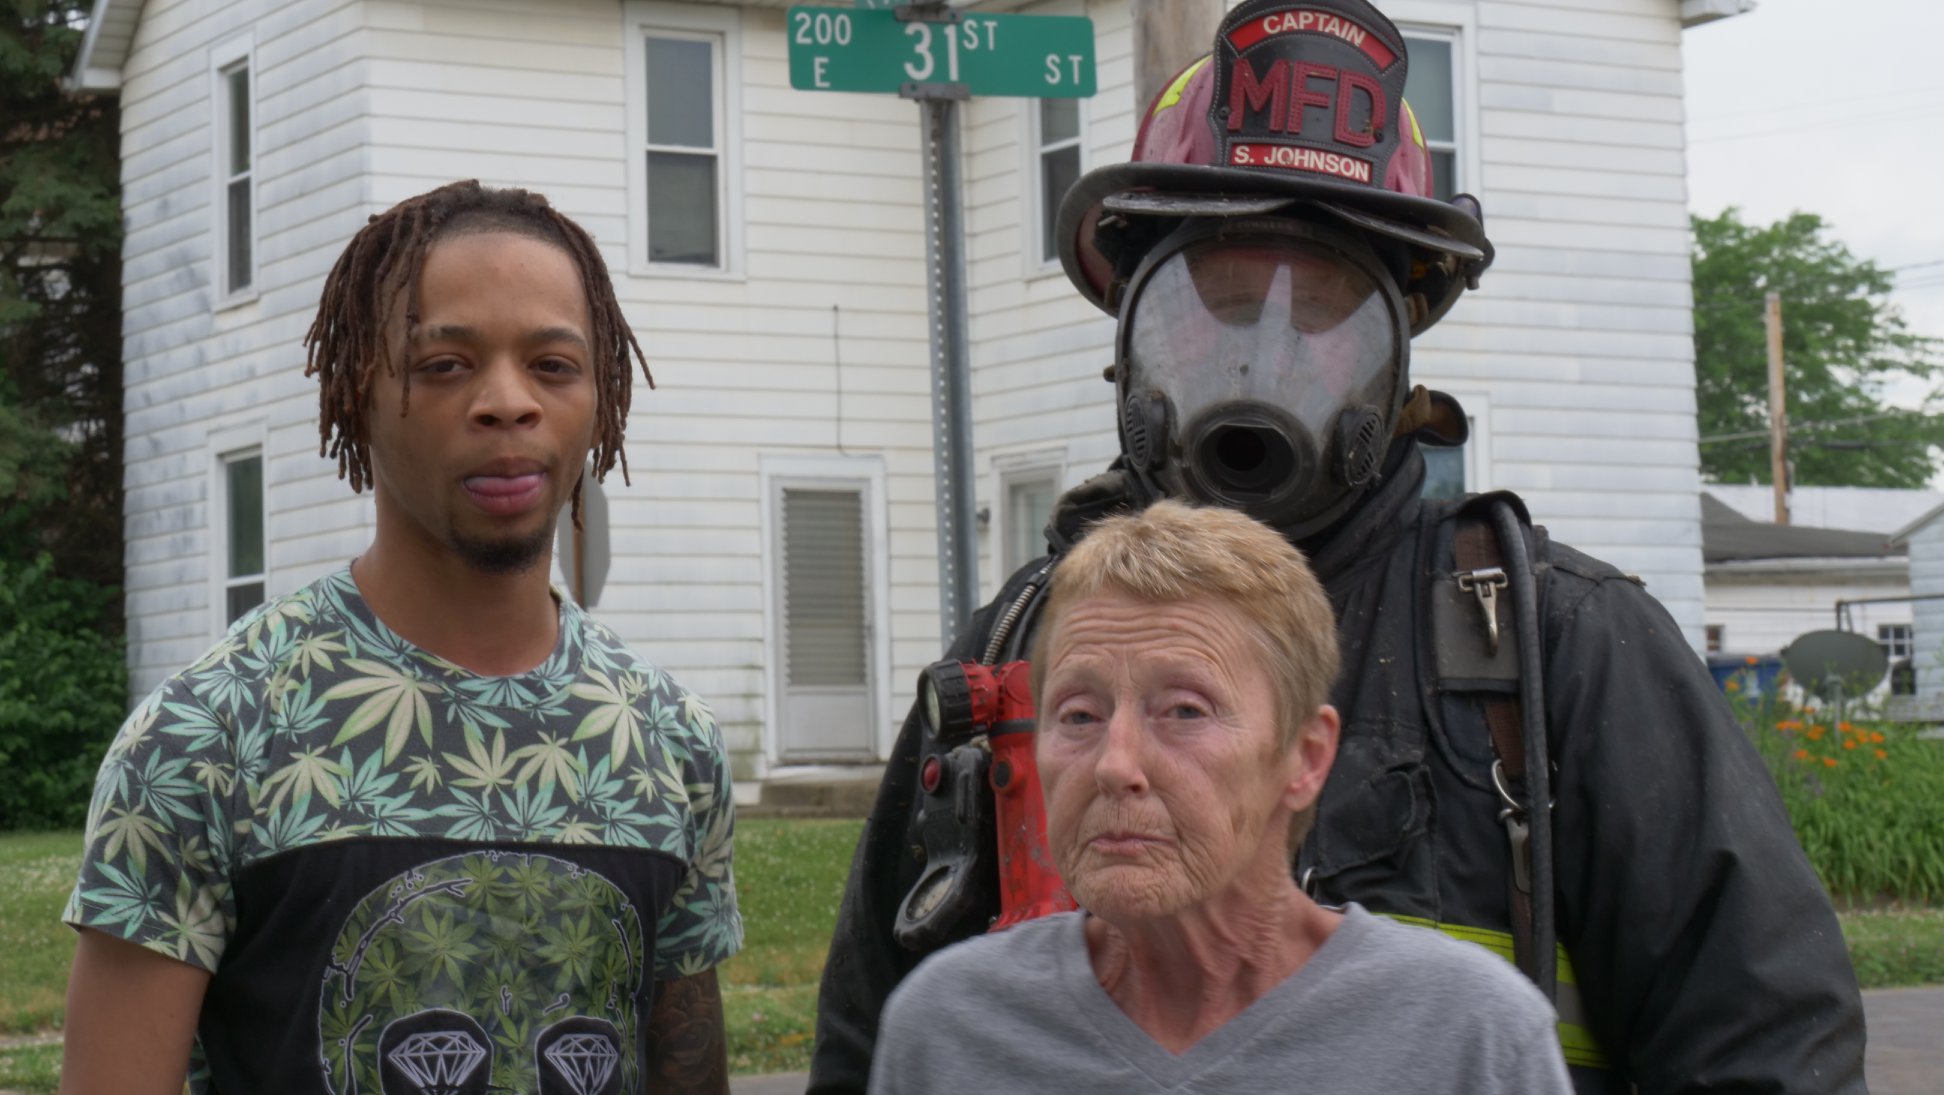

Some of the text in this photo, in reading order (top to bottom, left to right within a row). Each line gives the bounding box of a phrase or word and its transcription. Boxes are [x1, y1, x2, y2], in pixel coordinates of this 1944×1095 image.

[795, 12, 851, 45] 200
[1263, 11, 1366, 46] CAPTAIN
[814, 57, 830, 88] E
[1045, 54, 1083, 84] ST
[1226, 58, 1387, 147] MFD
[1234, 146, 1370, 182] S. JOHNSON
